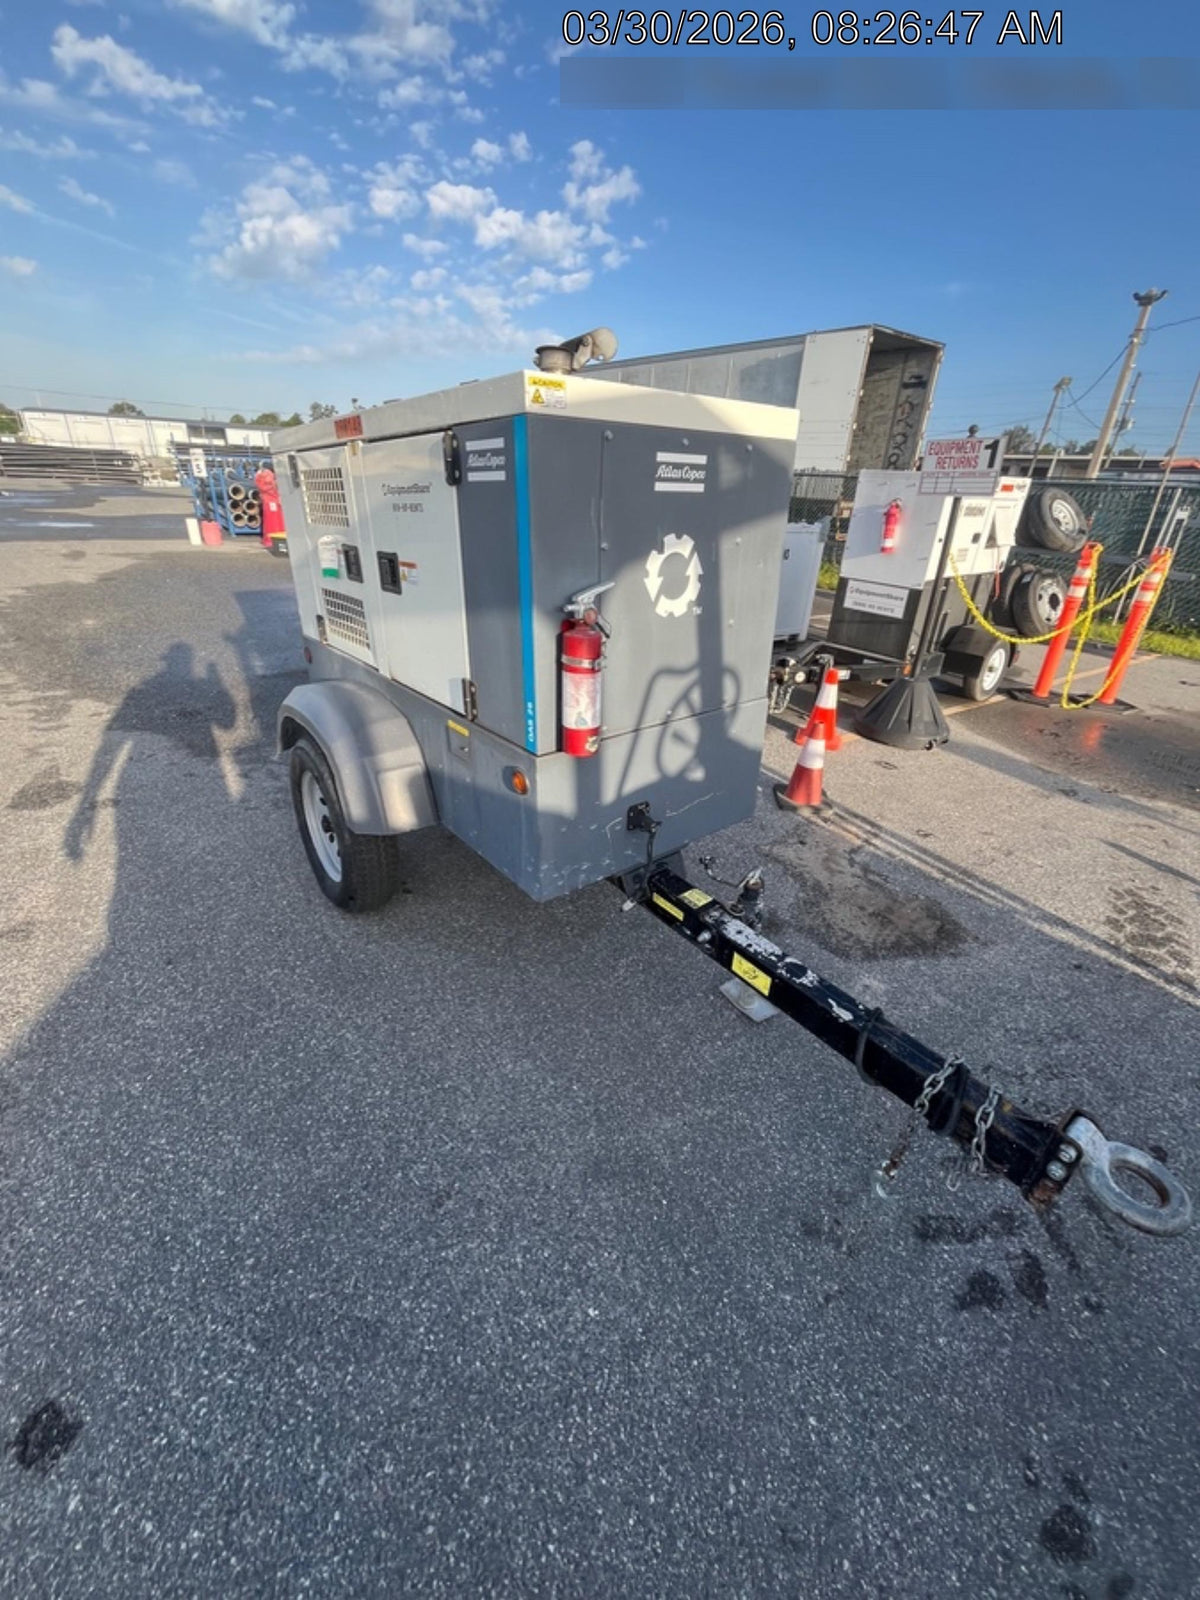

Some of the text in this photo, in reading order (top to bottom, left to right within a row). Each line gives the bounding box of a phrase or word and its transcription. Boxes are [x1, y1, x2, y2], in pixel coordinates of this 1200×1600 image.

[928, 438, 1000, 469] EQUIPMENT 1
[935, 455, 979, 470] RETURNS
[656, 464, 706, 481] Atlas Copco
